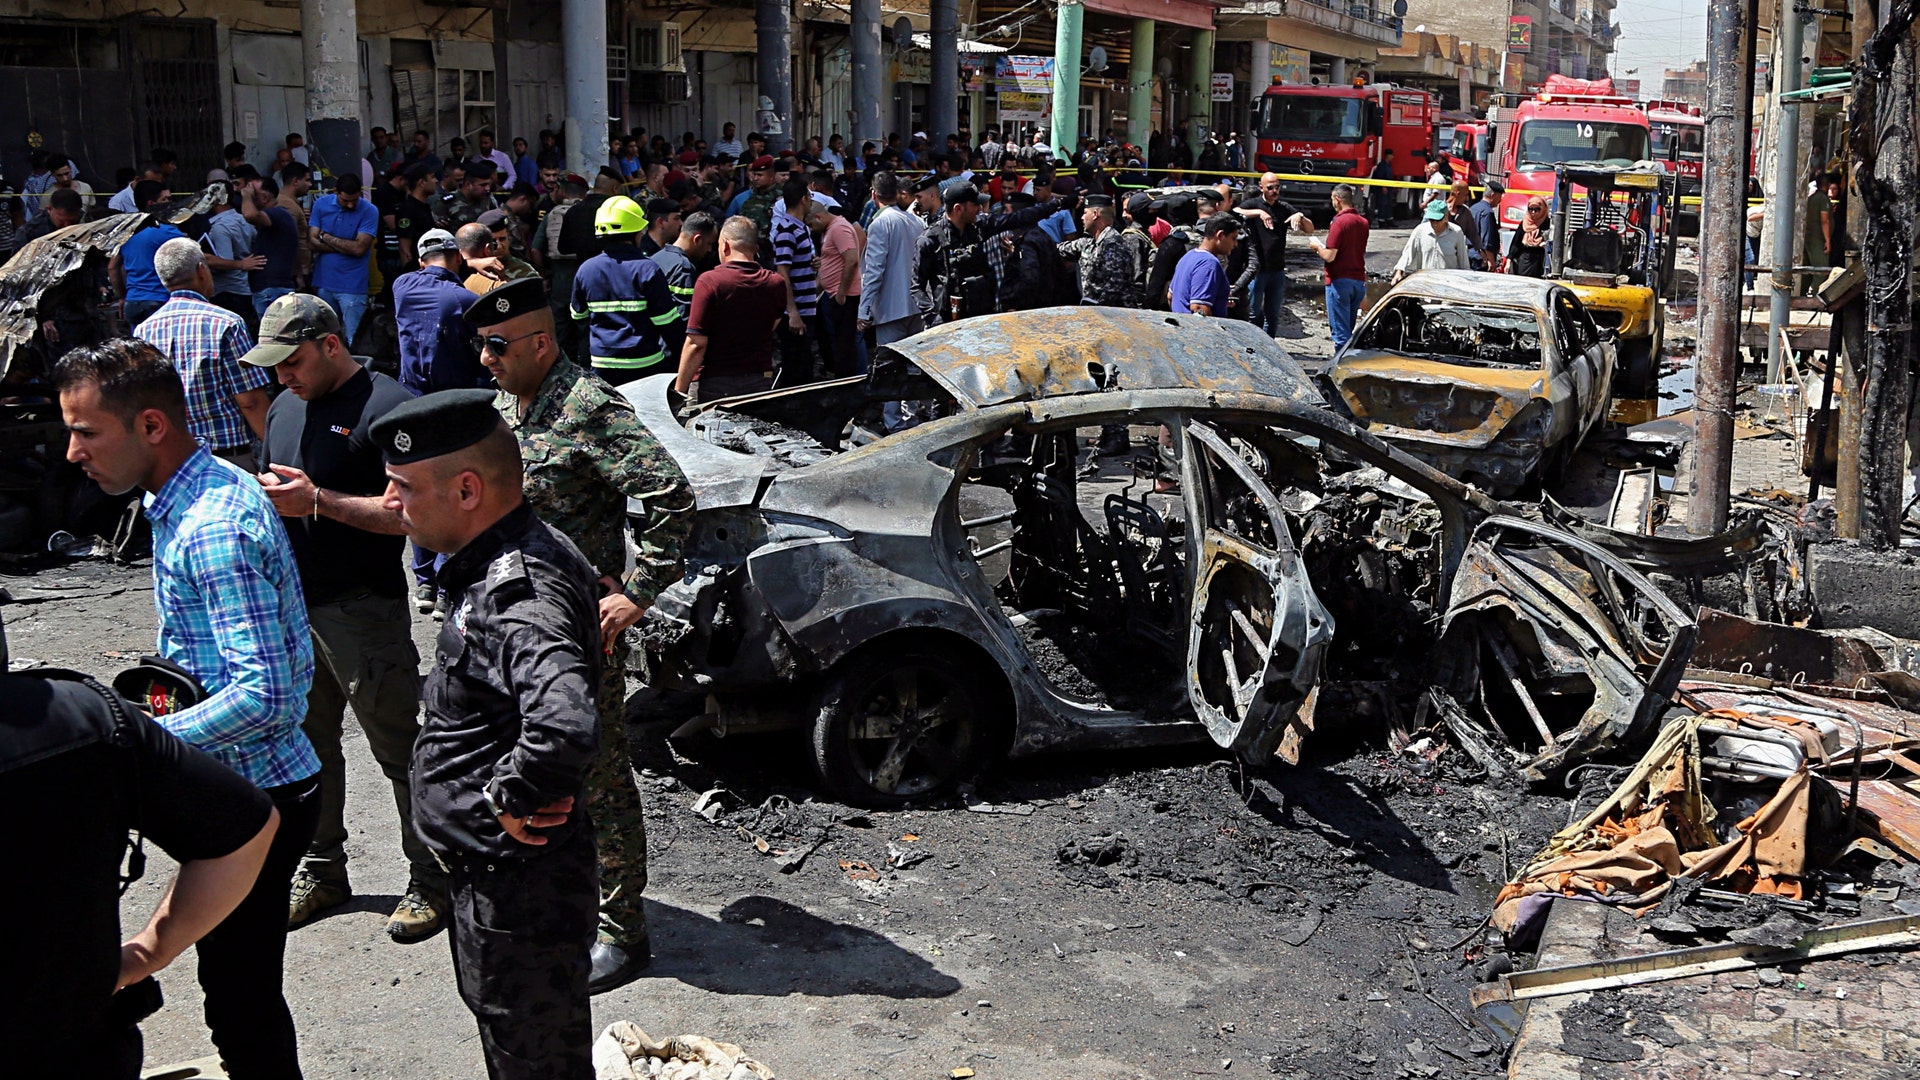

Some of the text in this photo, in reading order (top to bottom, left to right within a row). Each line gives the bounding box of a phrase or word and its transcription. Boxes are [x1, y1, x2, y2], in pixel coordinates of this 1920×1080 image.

[1006, 57, 1045, 66] فندق
[997, 68, 1032, 78] السلطان
[1576, 123, 1594, 138] ١٥
[1272, 142, 1283, 153] ١٥
